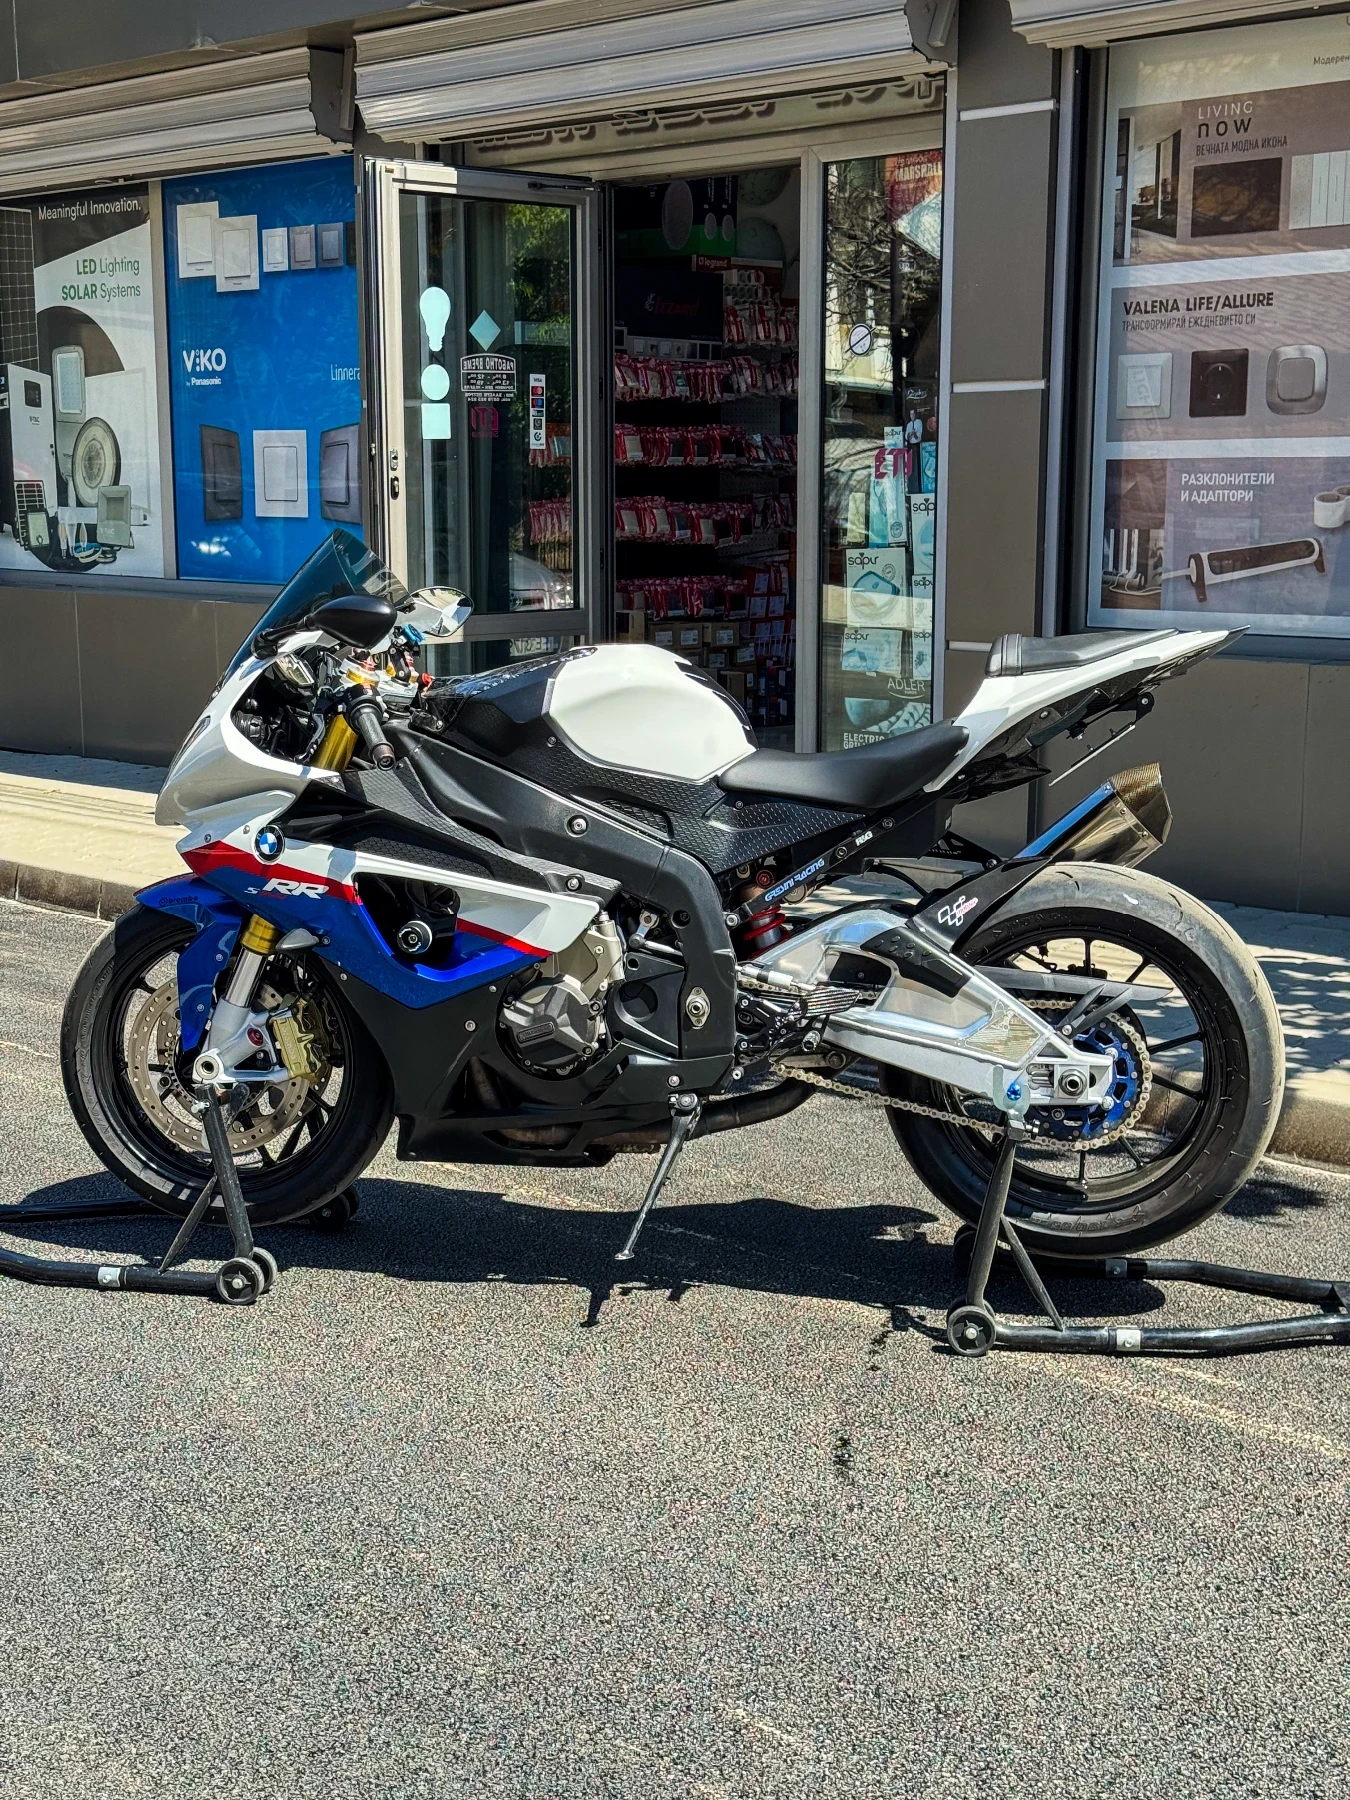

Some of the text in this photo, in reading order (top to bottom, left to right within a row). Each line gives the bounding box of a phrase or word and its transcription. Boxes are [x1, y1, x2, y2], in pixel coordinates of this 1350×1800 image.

[1198, 101, 1253, 119] LIVING
[1198, 118, 1252, 138] now
[1196, 135, 1288, 156] ВЕЧНАТА МОДНА ИКОНА
[38, 197, 141, 221] Meaningful Innovation.
[76, 256, 140, 277] LED Lighting
[704, 258, 728, 268] legrand
[61, 282, 141, 302] SOLAR Systems
[1123, 291, 1274, 316] VALENA LIFE/ALLURE
[1122, 313, 1256, 331] ТРАНСФОРМИРАЙ ЕЖЕДНЕВИЕТО СИ
[191, 376, 222, 386] Panasonic
[330, 364, 360, 381] Linnera
[874, 448, 913, 479] ETI
[1181, 473, 1275, 485] РАЗКЛОНИТЕЛИ
[1181, 490, 1253, 504] И АДАПТОРИ
[887, 677, 926, 692] ADLER
[262, 878, 329, 899] RR
[765, 858, 825, 902] GRESINI RACING
[168, 895, 199, 904] brembo
